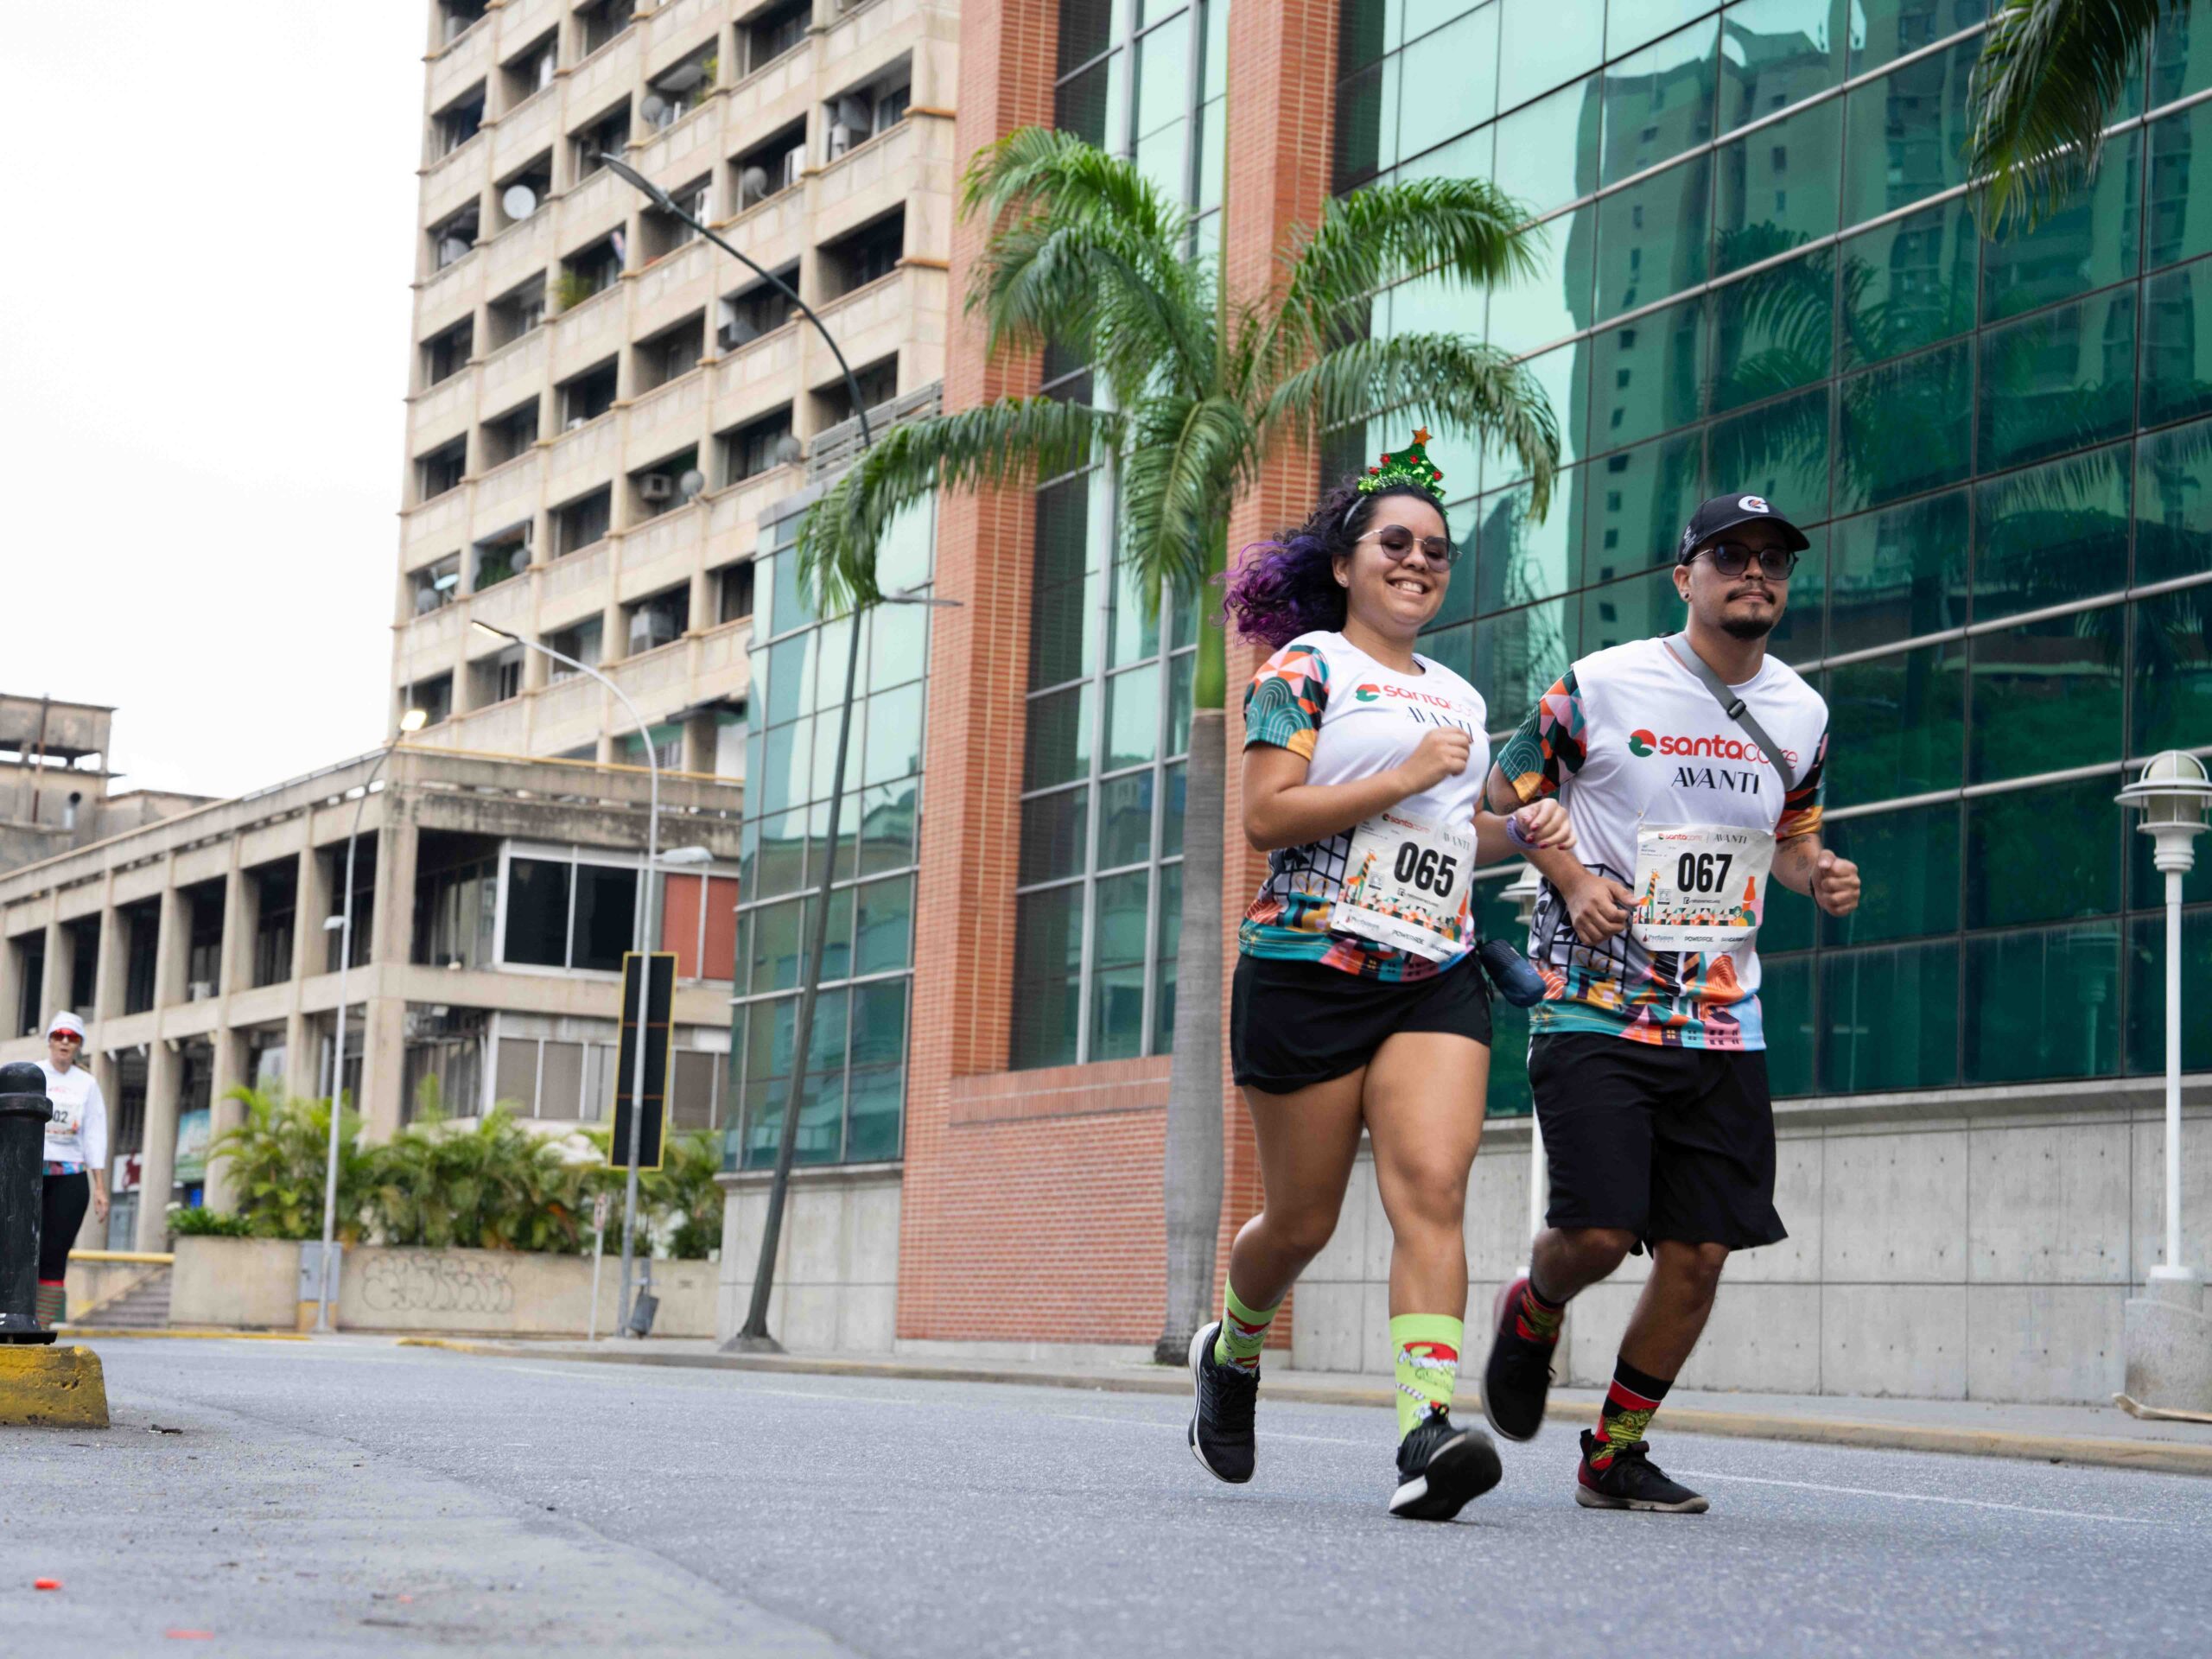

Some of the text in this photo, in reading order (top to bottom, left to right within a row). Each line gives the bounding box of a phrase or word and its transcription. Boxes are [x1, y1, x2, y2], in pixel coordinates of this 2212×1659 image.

[1671, 766, 1760, 794] AVANTI
[1713, 833, 1747, 844] AVANTI
[1394, 841, 1458, 898] 065
[1677, 852, 1733, 893] 067
[53, 1109, 68, 1124] 02
